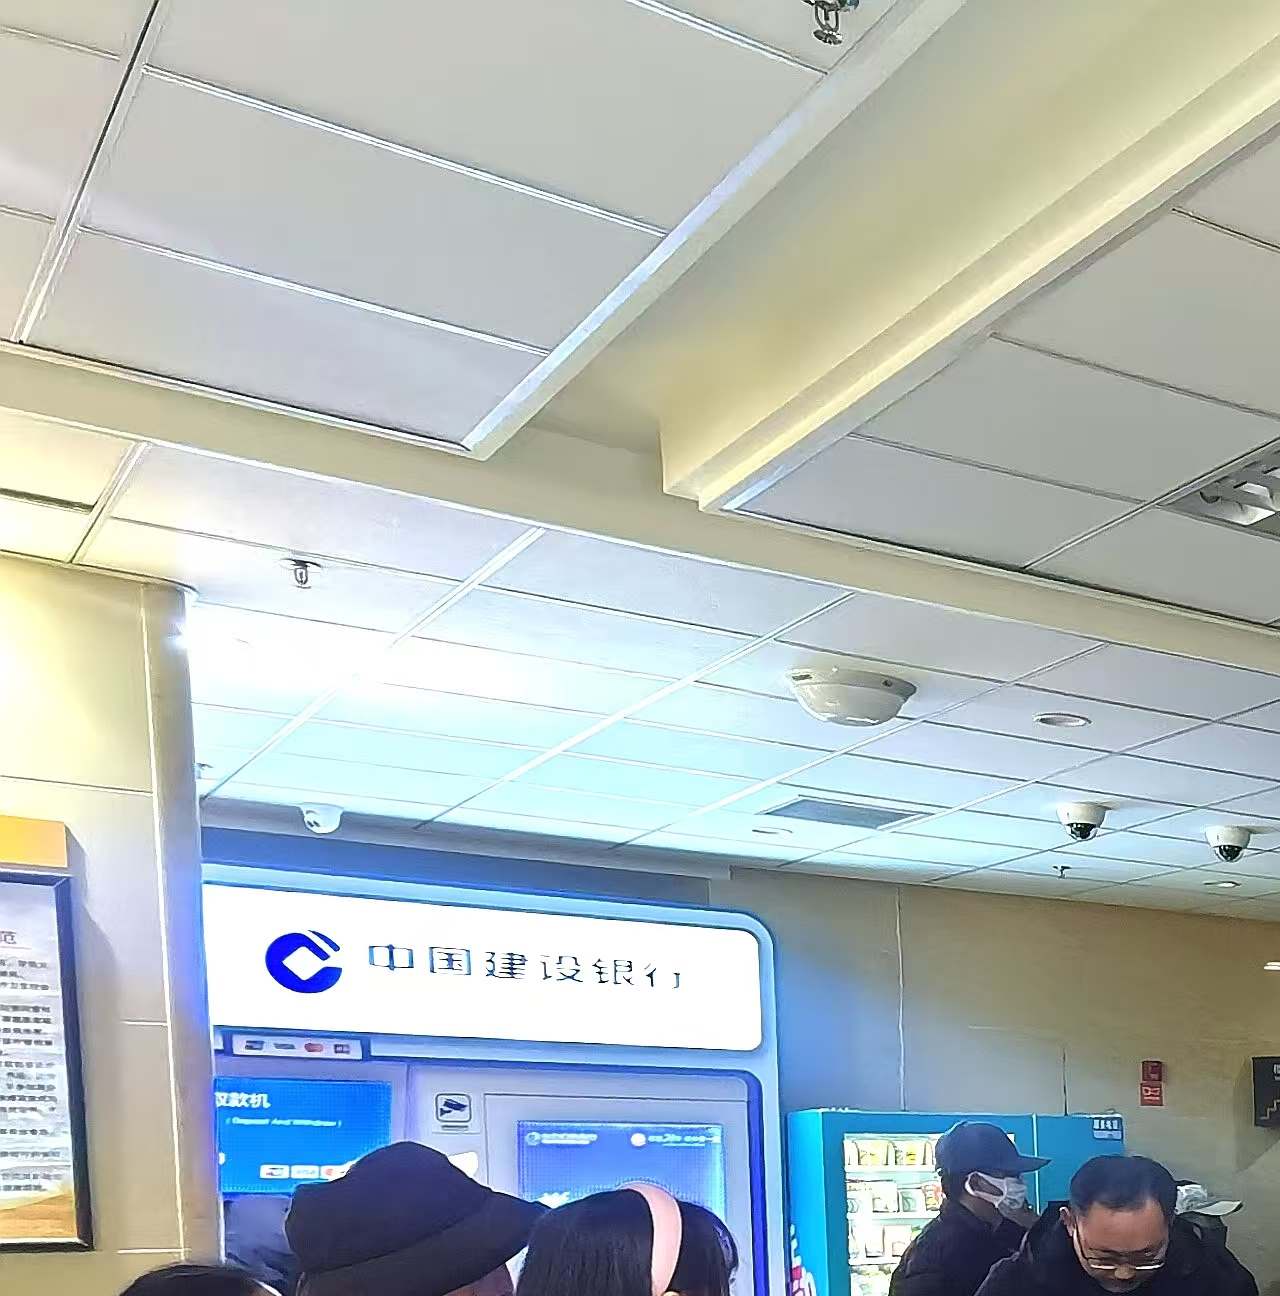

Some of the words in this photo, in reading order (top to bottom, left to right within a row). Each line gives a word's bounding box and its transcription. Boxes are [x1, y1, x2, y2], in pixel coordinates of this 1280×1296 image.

[368, 943, 682, 989] 中国建设银行
